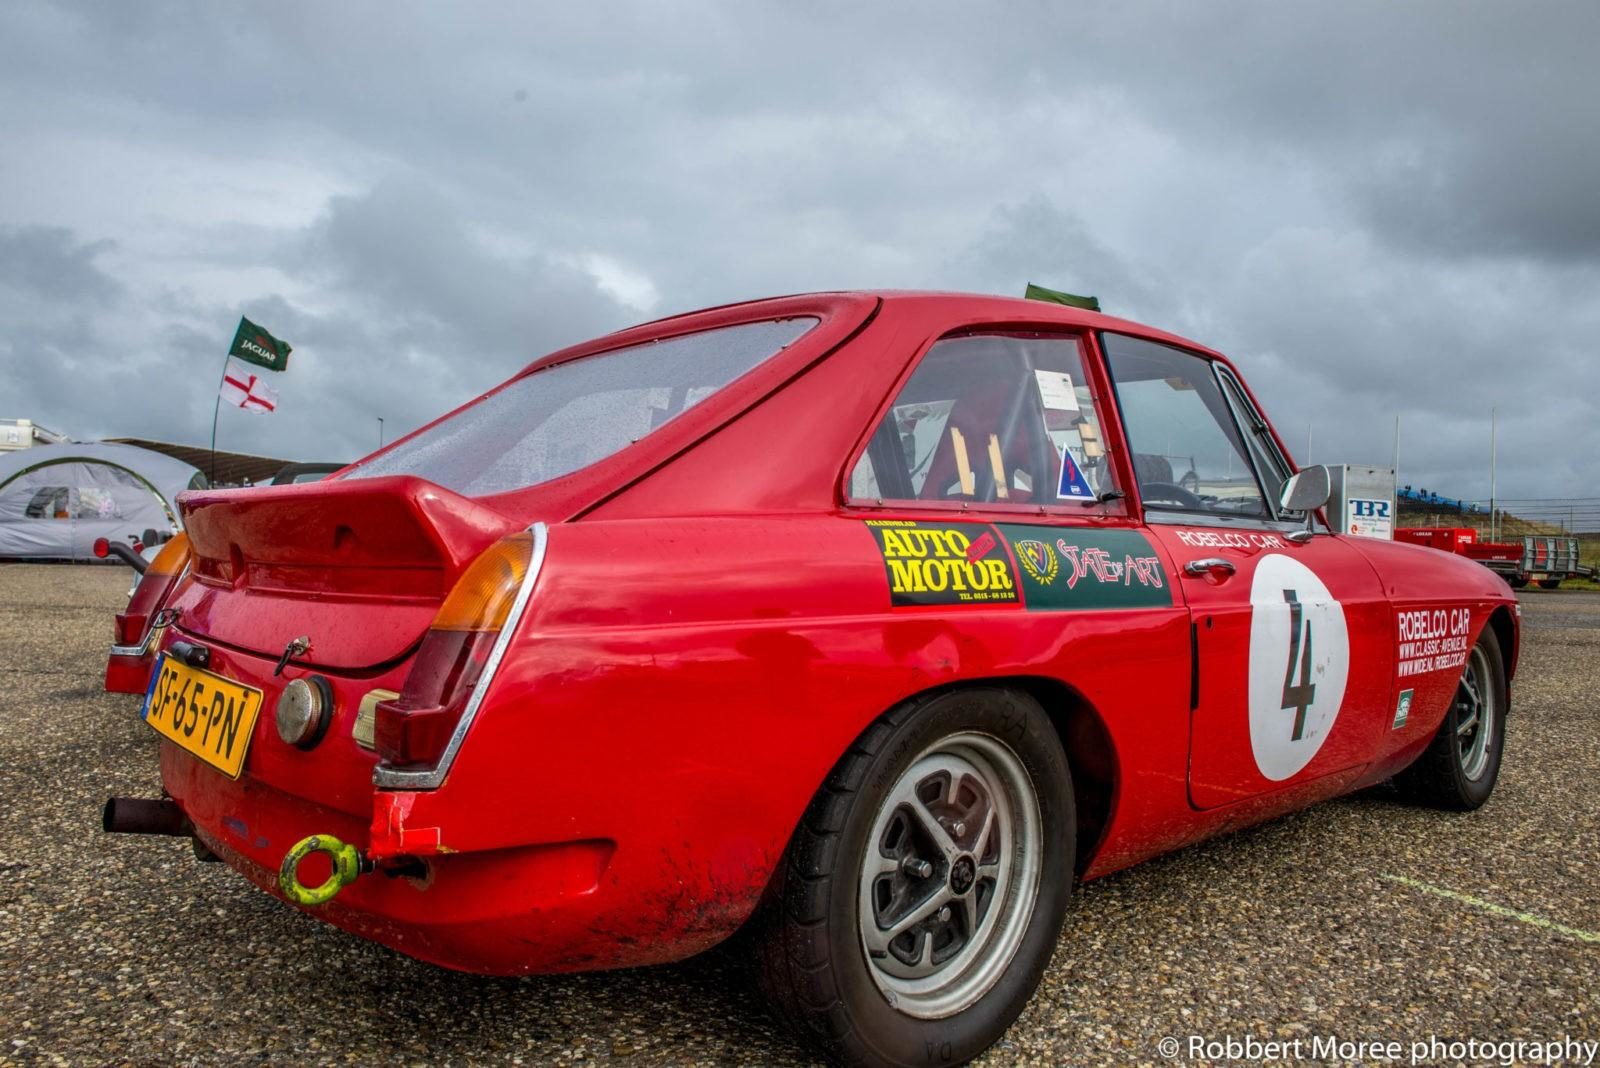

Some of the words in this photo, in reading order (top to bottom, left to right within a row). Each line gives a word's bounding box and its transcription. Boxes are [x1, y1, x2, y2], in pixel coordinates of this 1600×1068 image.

[241, 339, 276, 362] JAGUAR
[881, 529, 971, 557] AUTO
[1175, 530, 1250, 548] ROBELCO
[1249, 535, 1287, 549] CAR
[886, 558, 1013, 592] MOTOR
[1056, 538, 1119, 590] STATE
[1124, 554, 1163, 588] ART
[1398, 610, 1448, 641] ROBELCO
[1450, 608, 1470, 636] CAR
[1281, 588, 1316, 742] 4
[152, 667, 246, 760] SF-65-PN
